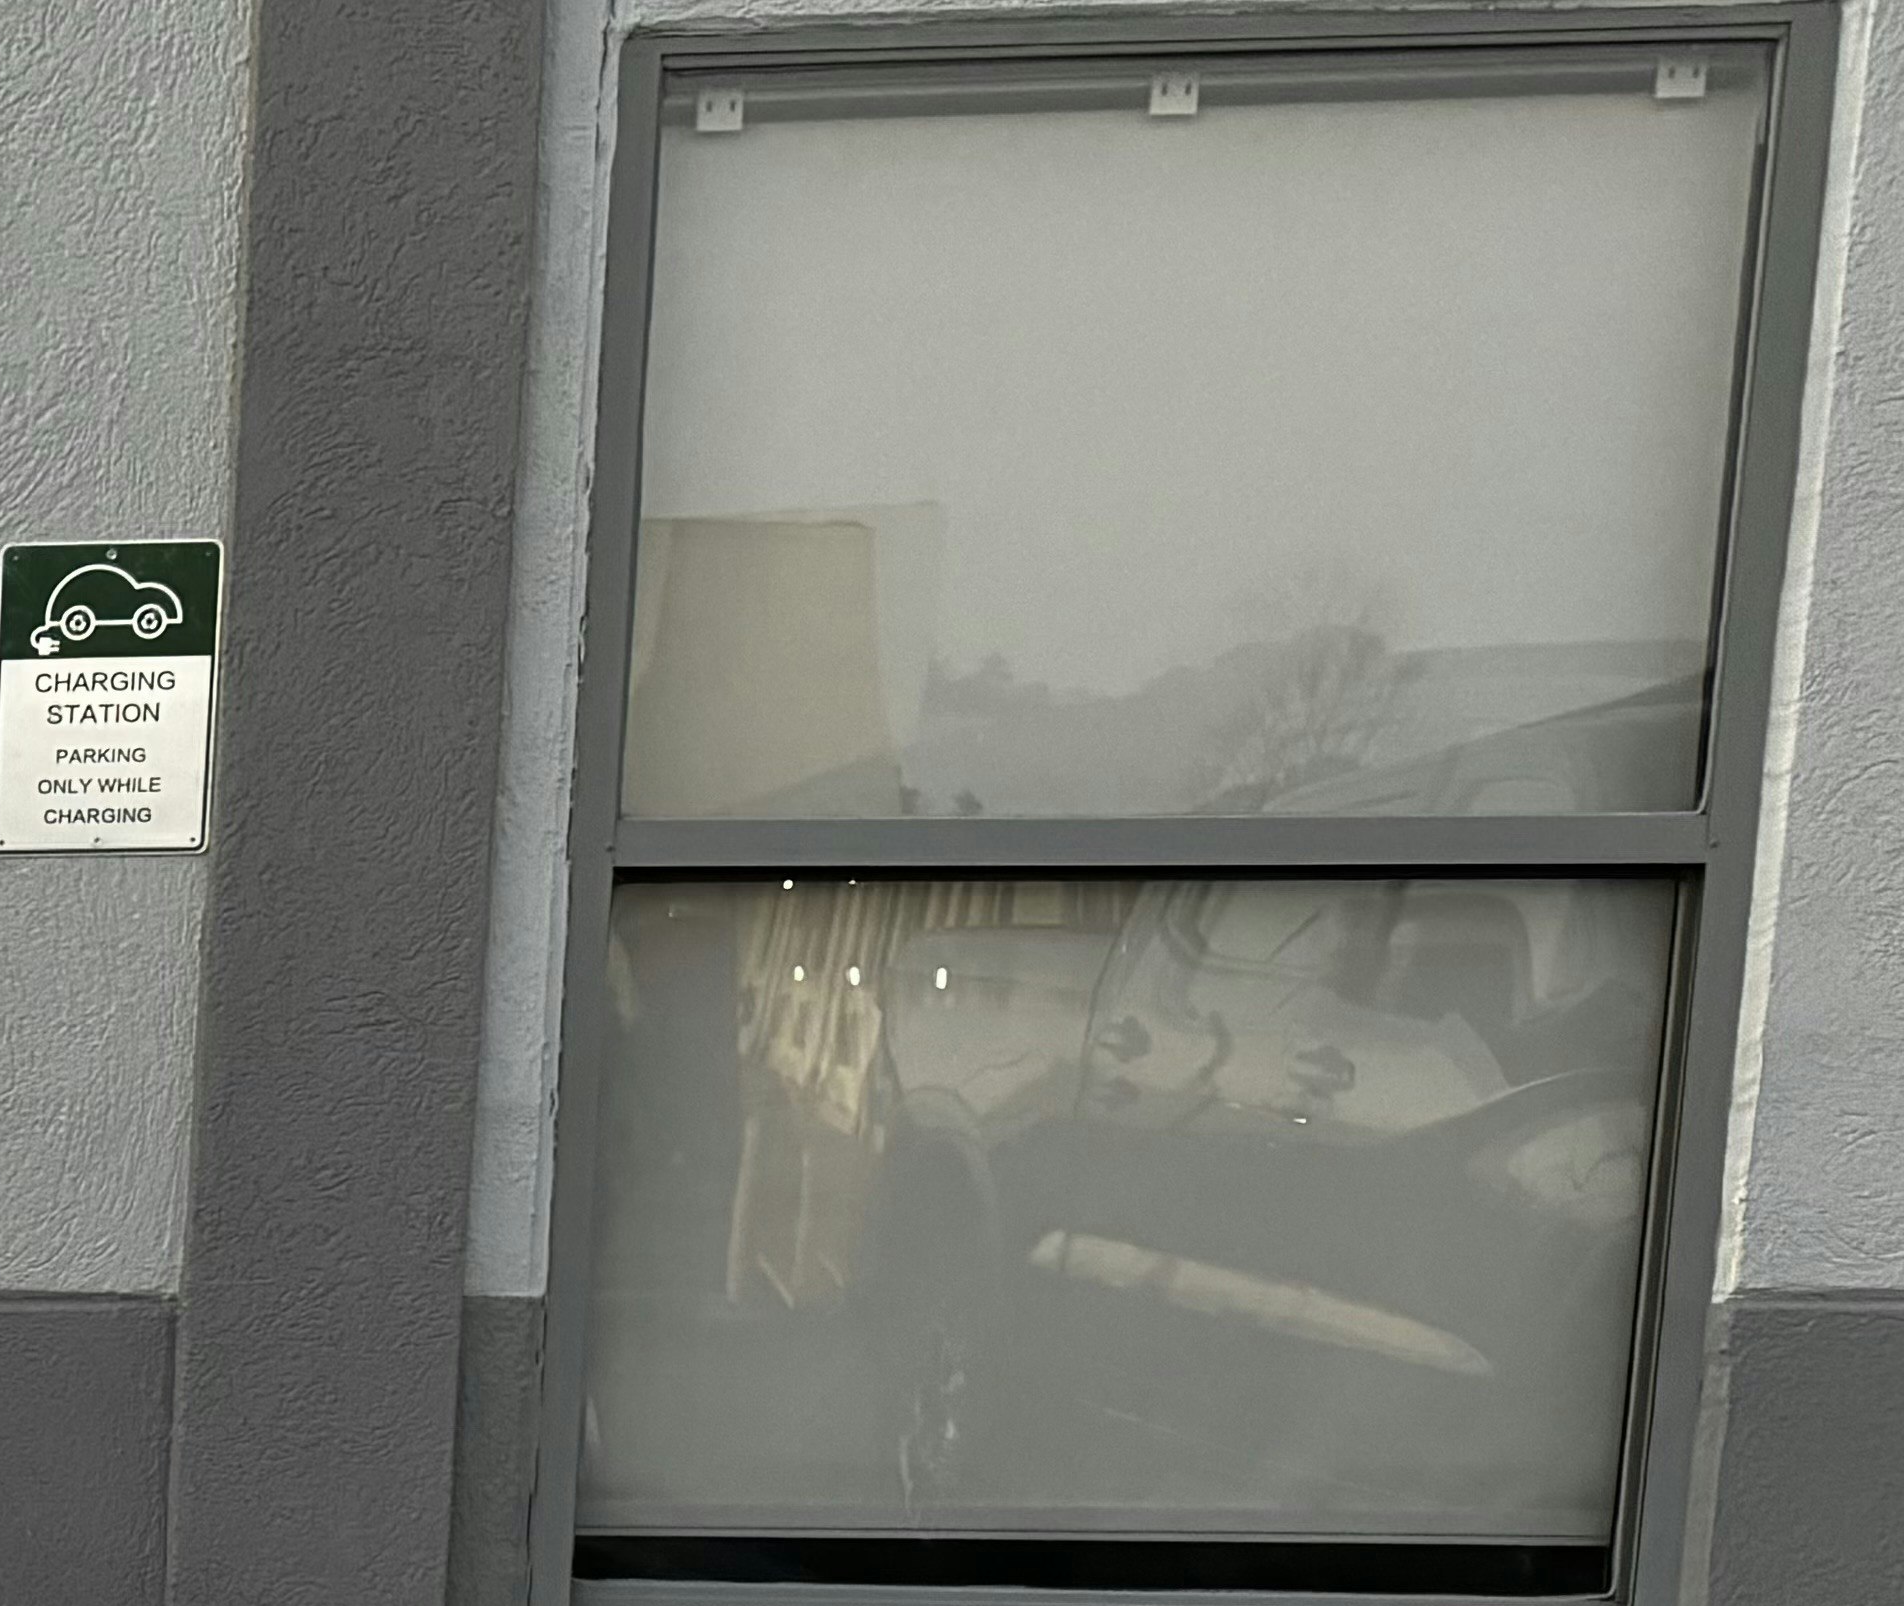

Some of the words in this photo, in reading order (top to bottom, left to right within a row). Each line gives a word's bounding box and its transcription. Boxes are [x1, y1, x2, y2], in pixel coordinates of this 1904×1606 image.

[34, 670, 176, 694] CHARGING
[46, 702, 161, 725] STATION
[55, 747, 147, 764] PARKING
[37, 778, 93, 795] ONLY
[97, 776, 162, 794] WHILE
[43, 807, 152, 825] CHARGING
